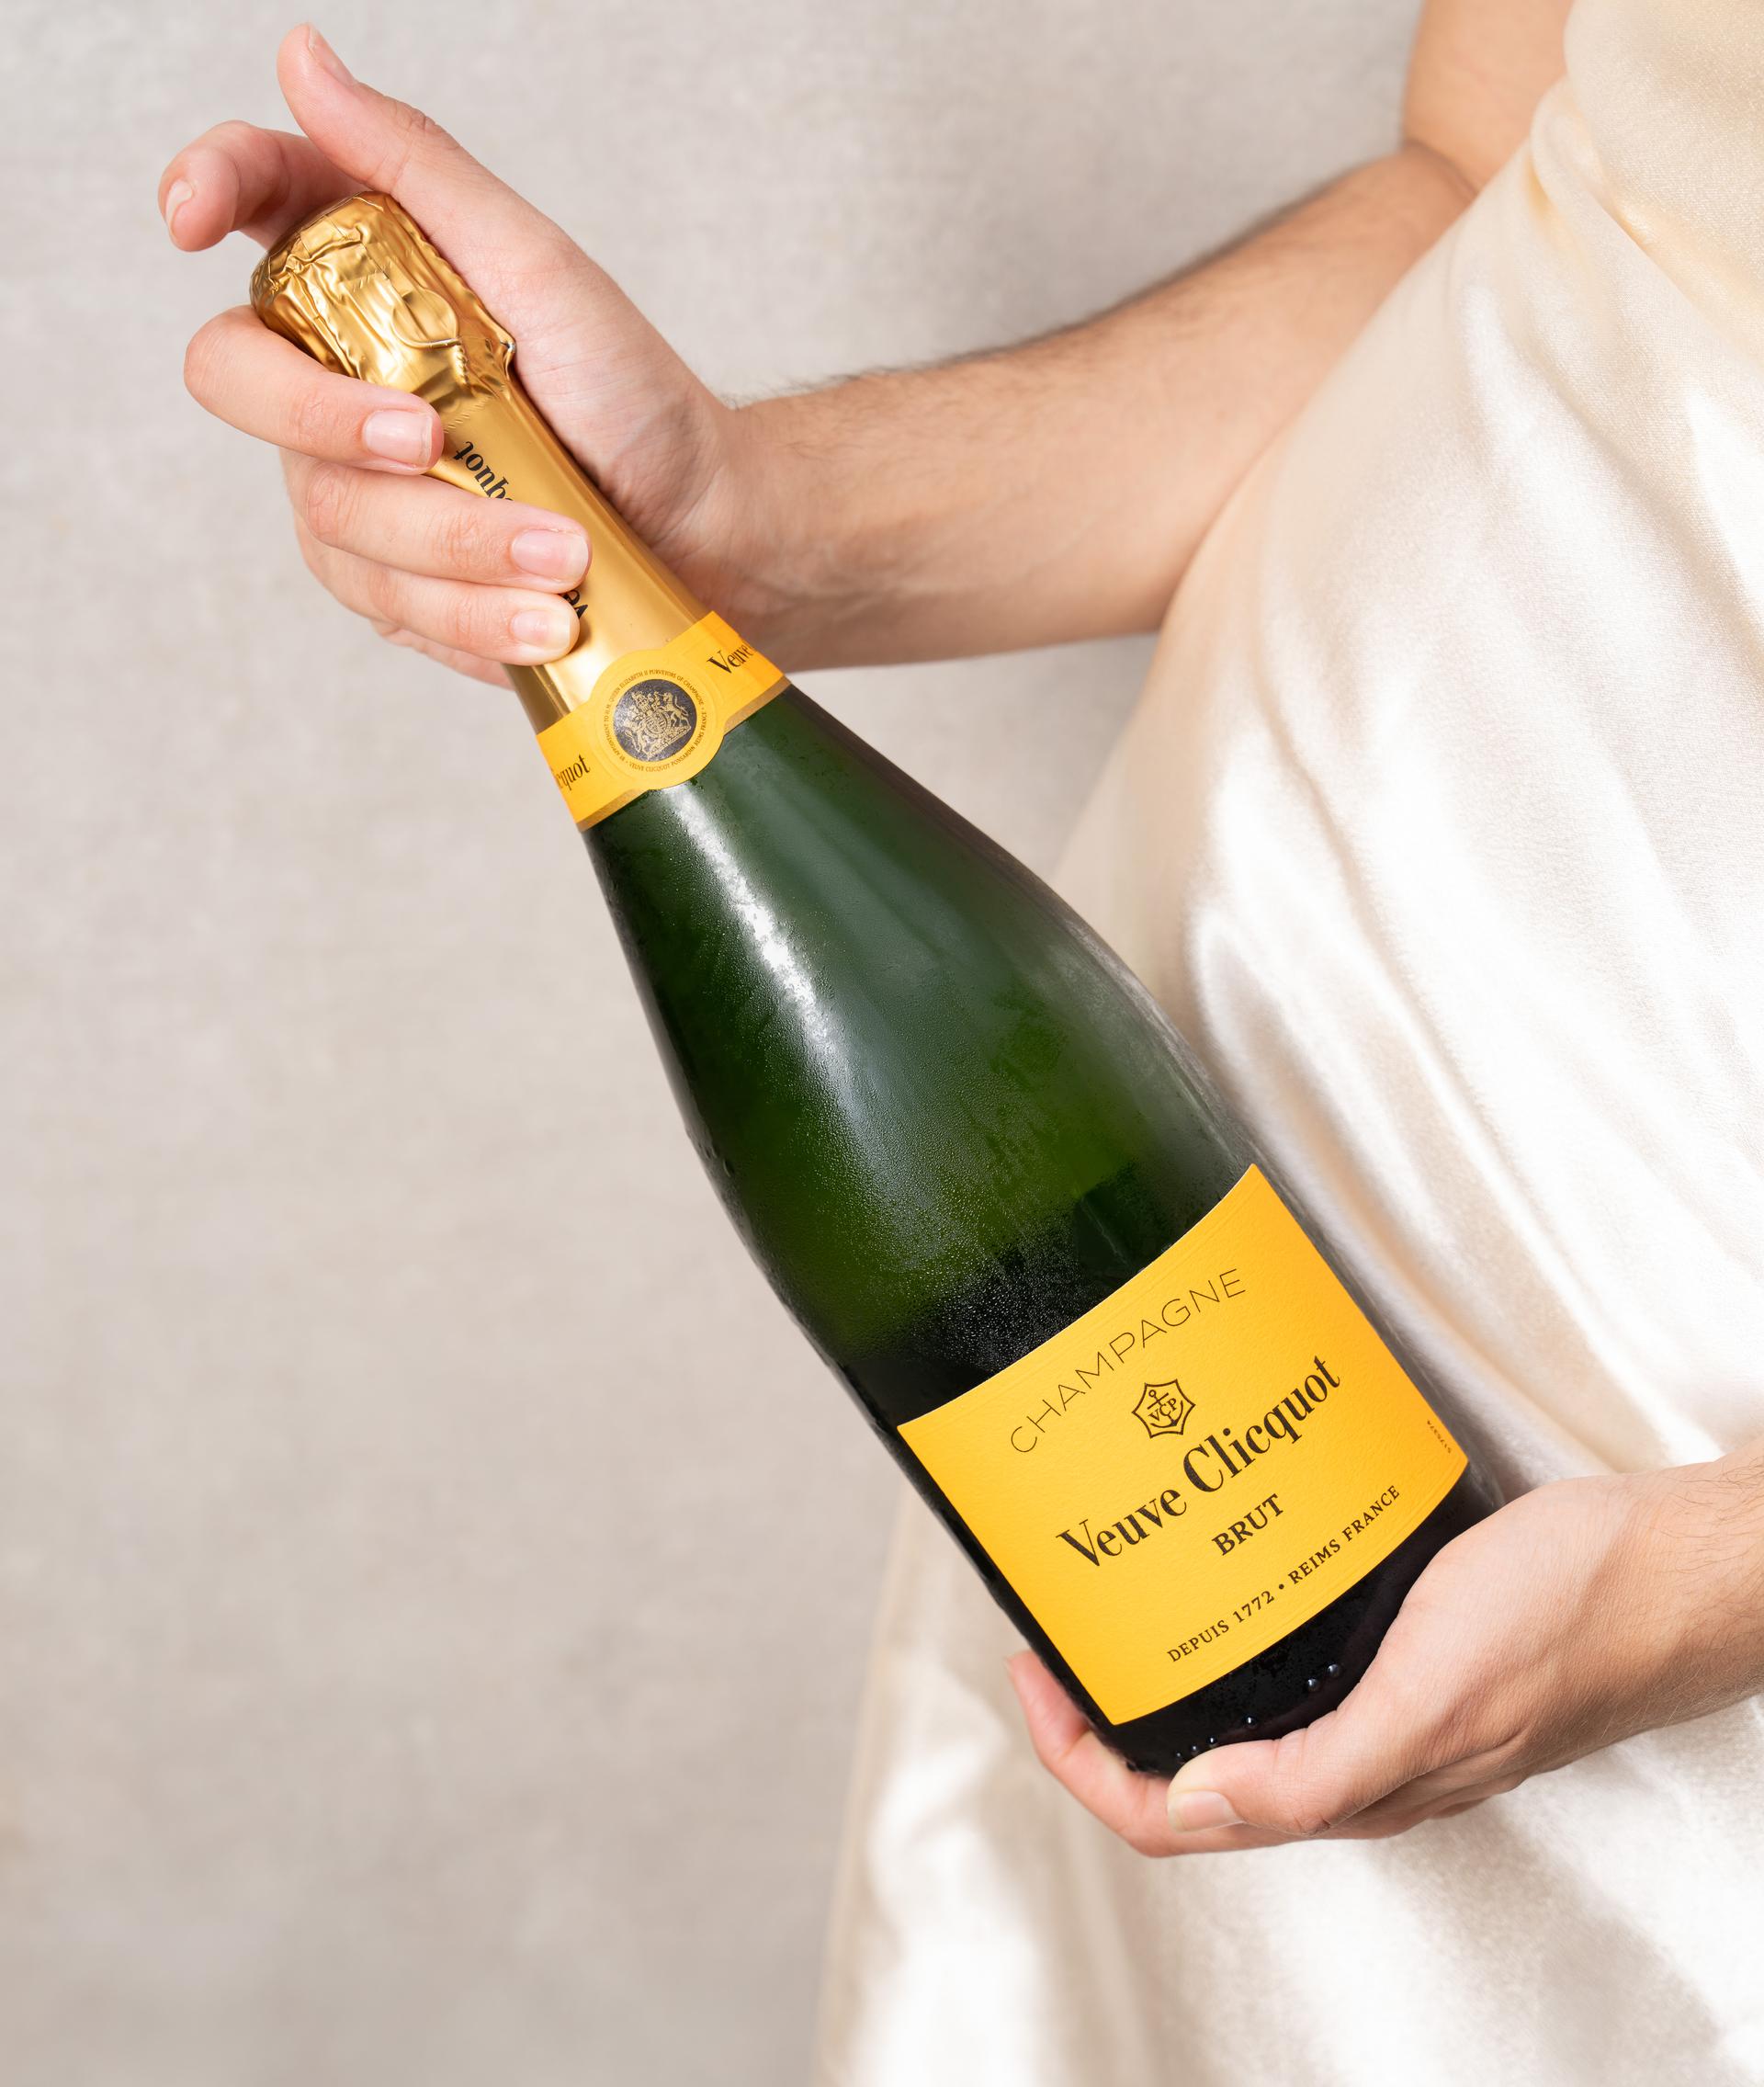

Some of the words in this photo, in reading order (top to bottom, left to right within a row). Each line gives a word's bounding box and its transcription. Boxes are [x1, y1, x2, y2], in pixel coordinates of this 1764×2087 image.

[453, 441, 513, 501] quot
[1011, 1268, 1246, 1453] CHAMPAGNE
[1148, 1397, 1177, 1422] VCP
[1056, 1488, 1187, 1567] Veuve
[1182, 1355, 1340, 1493] Clicquot
[1166, 1619, 1230, 1662] DEPUIS
[1232, 1590, 1275, 1623] 1772
[1287, 1538, 1341, 1584] REIMS
[1341, 1485, 1400, 1542] FRANCE
[1211, 1493, 1284, 1556] BRUT
